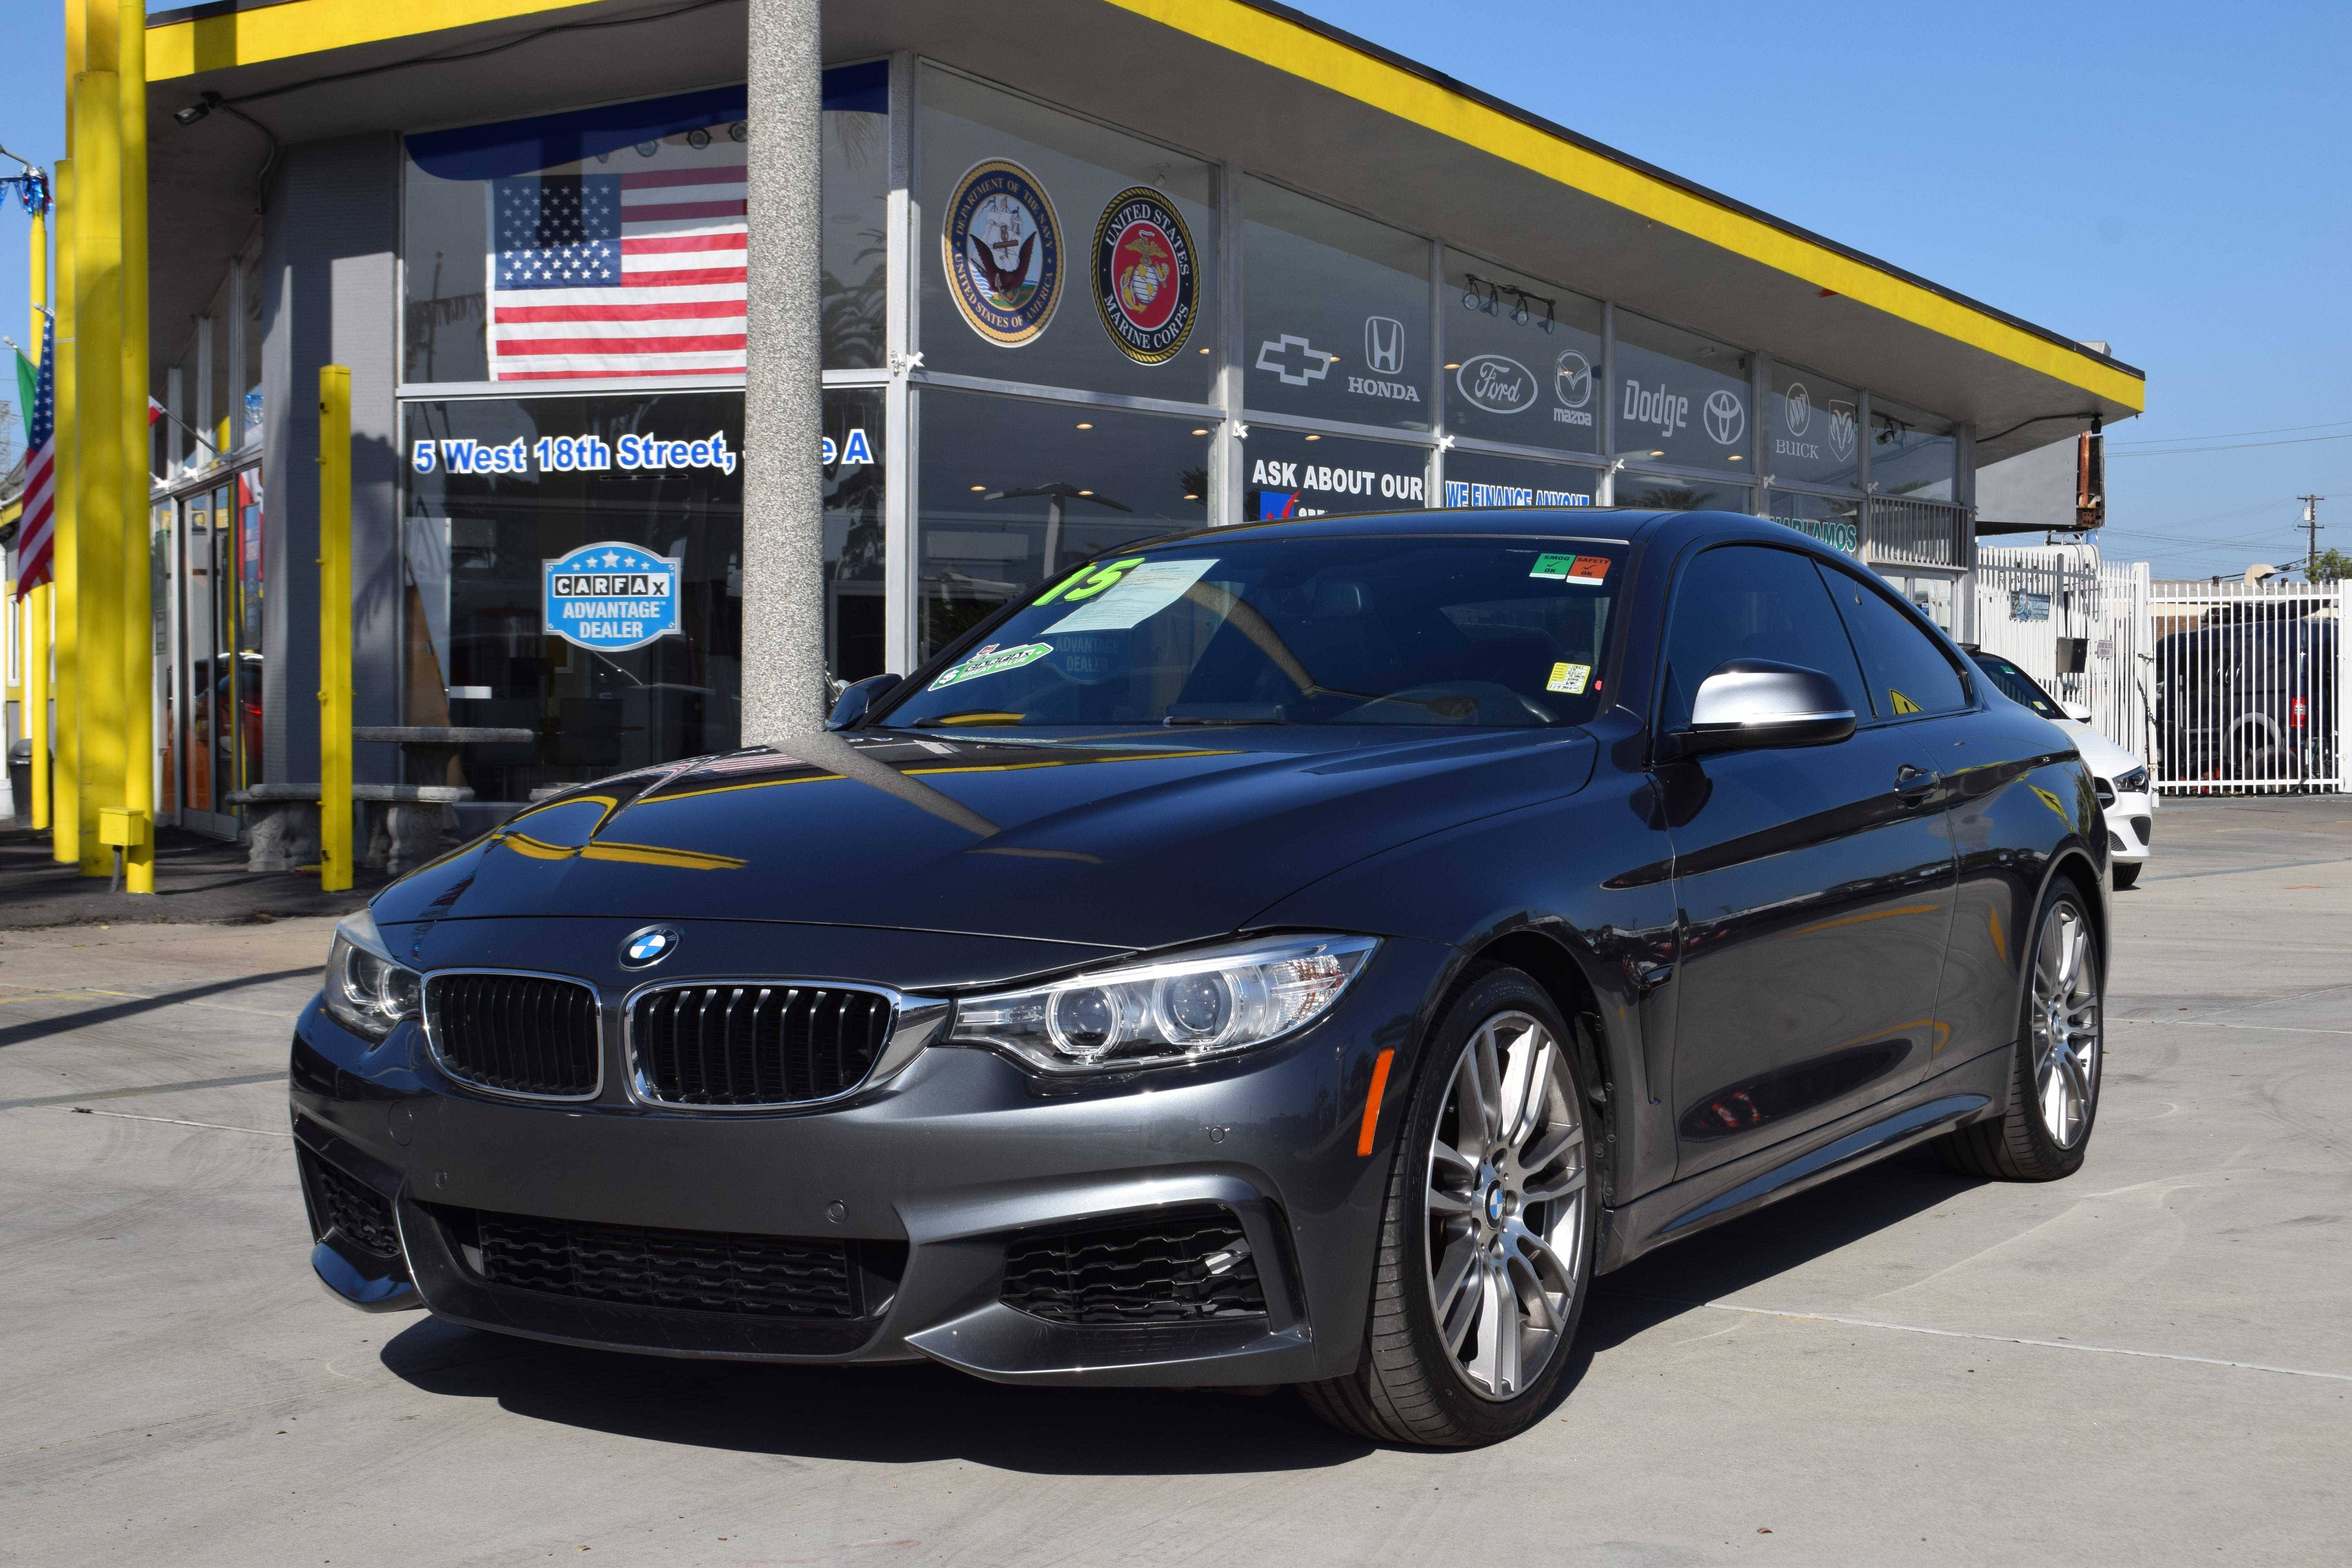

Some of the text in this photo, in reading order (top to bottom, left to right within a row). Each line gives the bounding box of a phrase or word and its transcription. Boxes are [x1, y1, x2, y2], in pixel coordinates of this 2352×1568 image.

[956, 178, 1054, 249] DEPARTMENT OF THE NAVY
[1105, 204, 1190, 276] UNITED STATES
[954, 253, 1054, 328] UNITED STATES OF AMERICA
[1104, 294, 1189, 349] MARINE CORPS
[1348, 376, 1420, 403] HONDA
[1475, 361, 1522, 403] Ford
[1623, 379, 1688, 437] Dodge
[412, 440, 436, 474] 5
[440, 436, 527, 474] West
[534, 434, 611, 472] 18th
[616, 430, 736, 475] Street,
[841, 428, 874, 464] A
[1775, 439, 1819, 459] BUICK
[1252, 459, 1423, 501] ASK ABOUT OUR
[1445, 480, 1469, 507] WE
[1471, 483, 1532, 507] FINANCE
[557, 578, 665, 595] CARFAX
[1032, 557, 1146, 607] 15
[579, 621, 643, 638] DEALER
[960, 665, 994, 678] GREAT
[996, 657, 1029, 669] VALUE
[967, 649, 1033, 671] CARFAX
